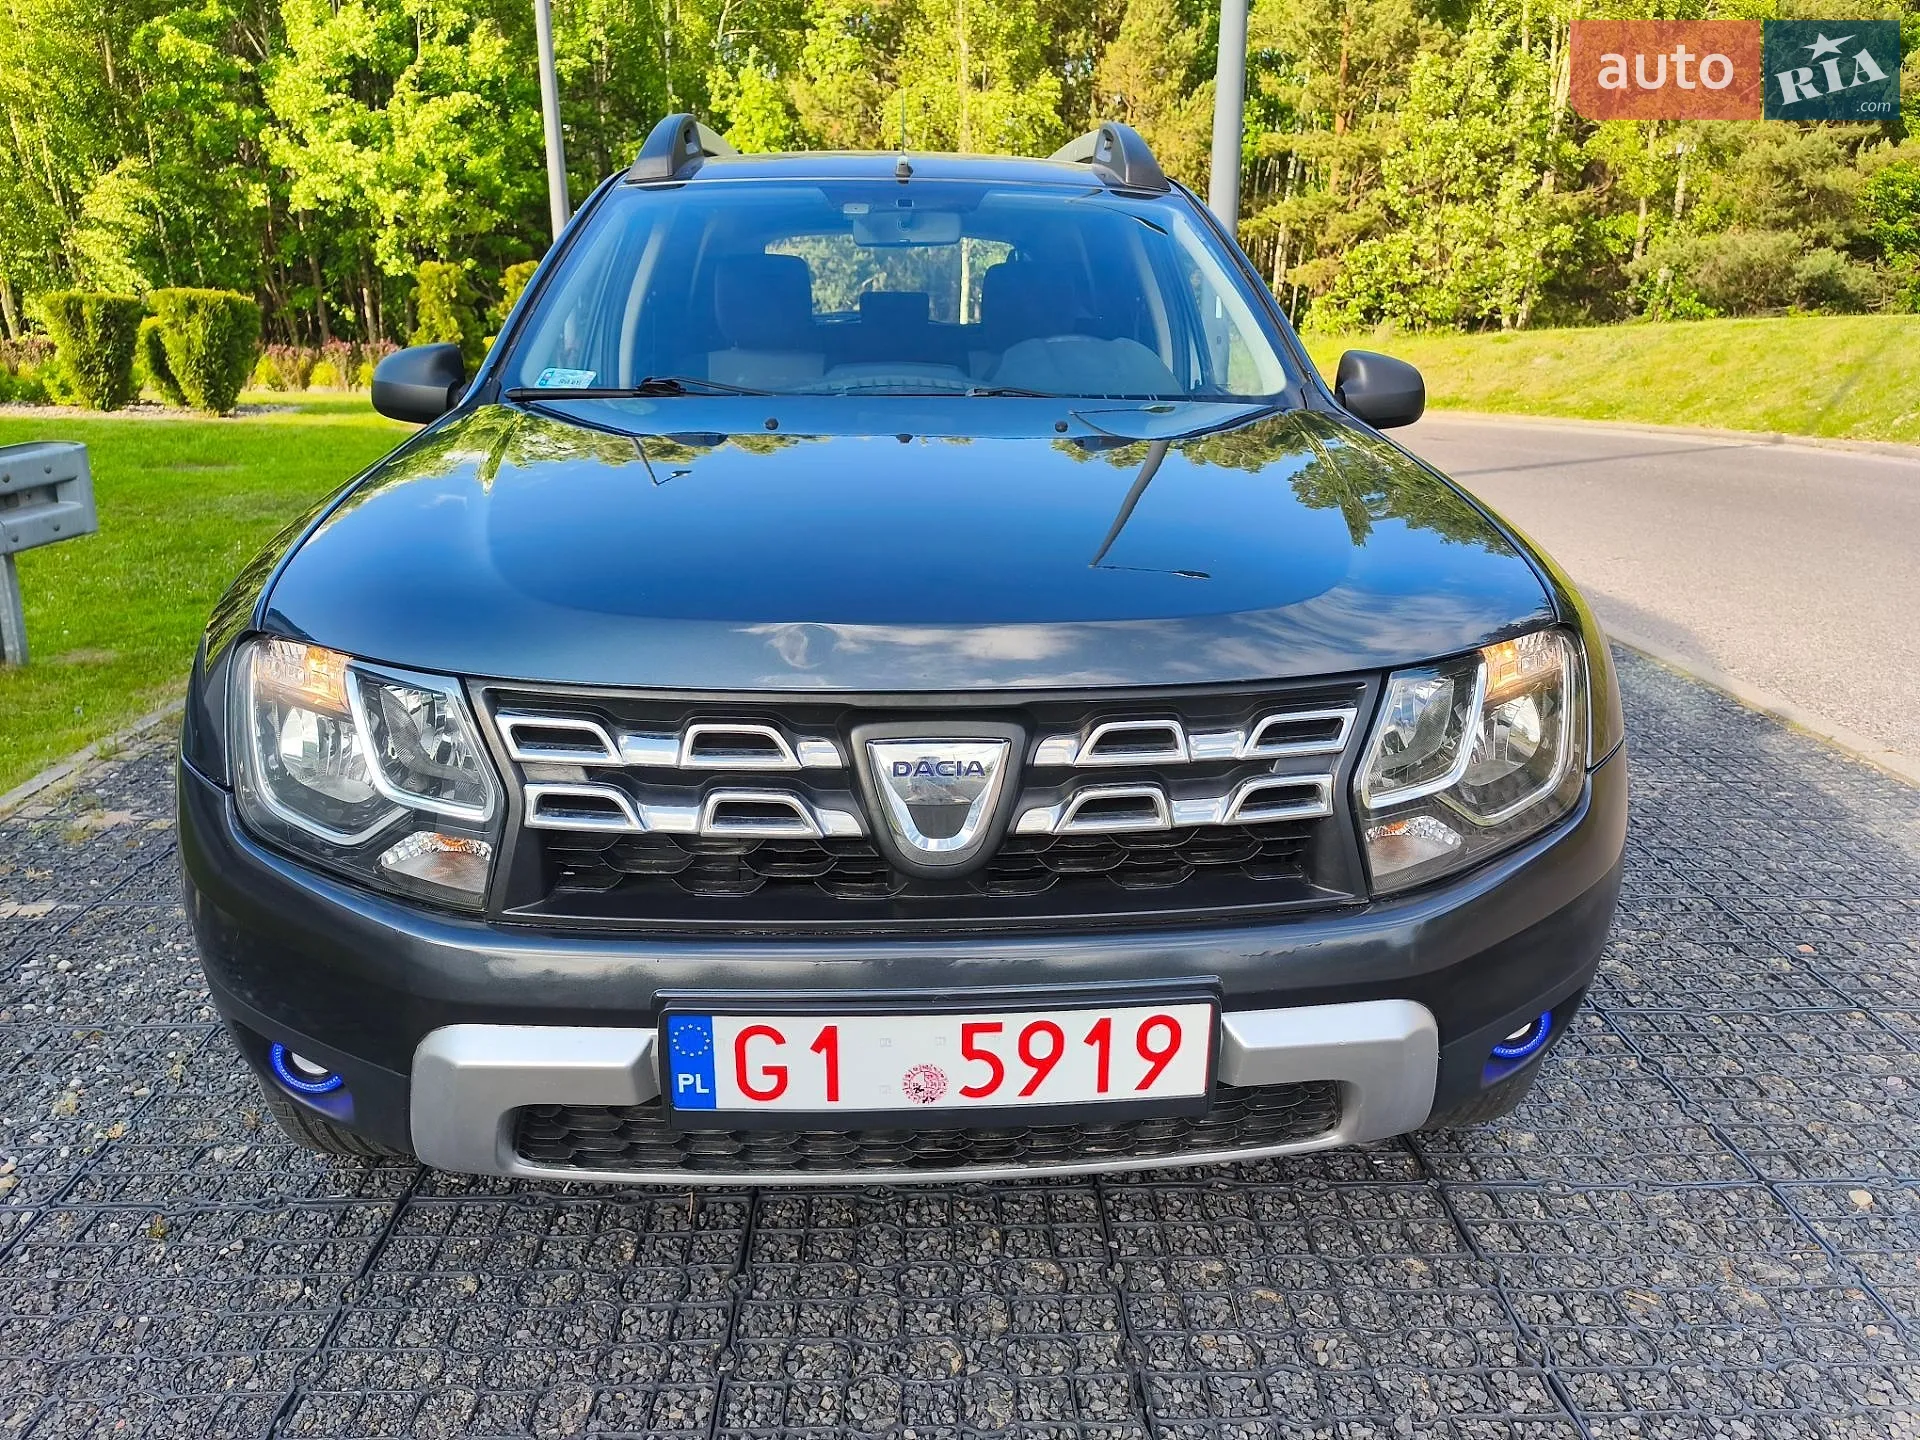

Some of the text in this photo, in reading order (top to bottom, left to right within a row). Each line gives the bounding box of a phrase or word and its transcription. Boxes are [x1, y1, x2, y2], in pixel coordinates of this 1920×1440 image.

[892, 760, 986, 778] DACIA
[734, 1024, 839, 1102] G1
[958, 1014, 1182, 1098] 5919
[678, 1073, 710, 1094] PL
